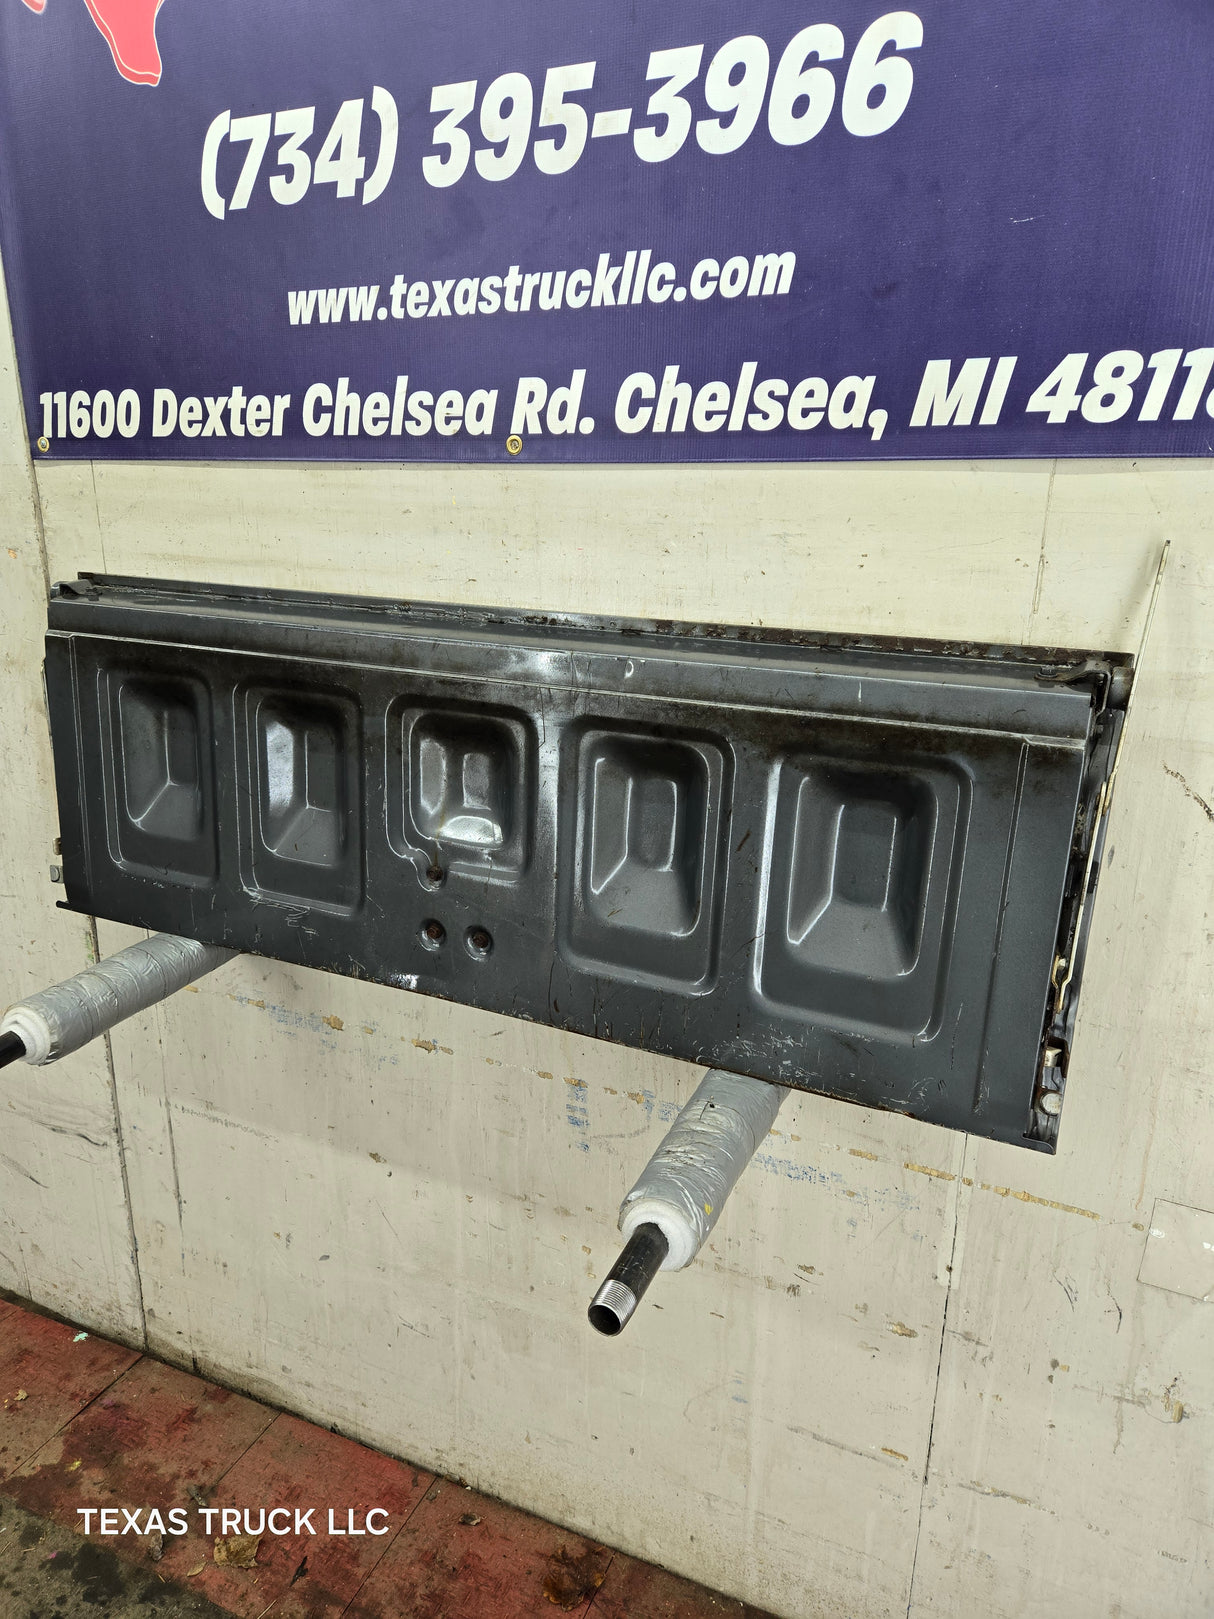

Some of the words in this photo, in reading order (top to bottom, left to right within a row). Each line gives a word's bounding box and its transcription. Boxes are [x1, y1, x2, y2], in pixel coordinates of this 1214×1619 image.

[200, 85, 399, 221] (734)
[421, 10, 924, 189] 395-3966
[287, 249, 797, 326] www.texastruckllc.com
[38, 388, 141, 439] 11600
[152, 385, 291, 438] Dexter
[302, 374, 499, 437] Chelsea
[509, 368, 595, 435] Rd.
[614, 361, 889, 441] Chelsea,
[908, 355, 1018, 427] MI
[1025, 347, 1214, 424] 4811
